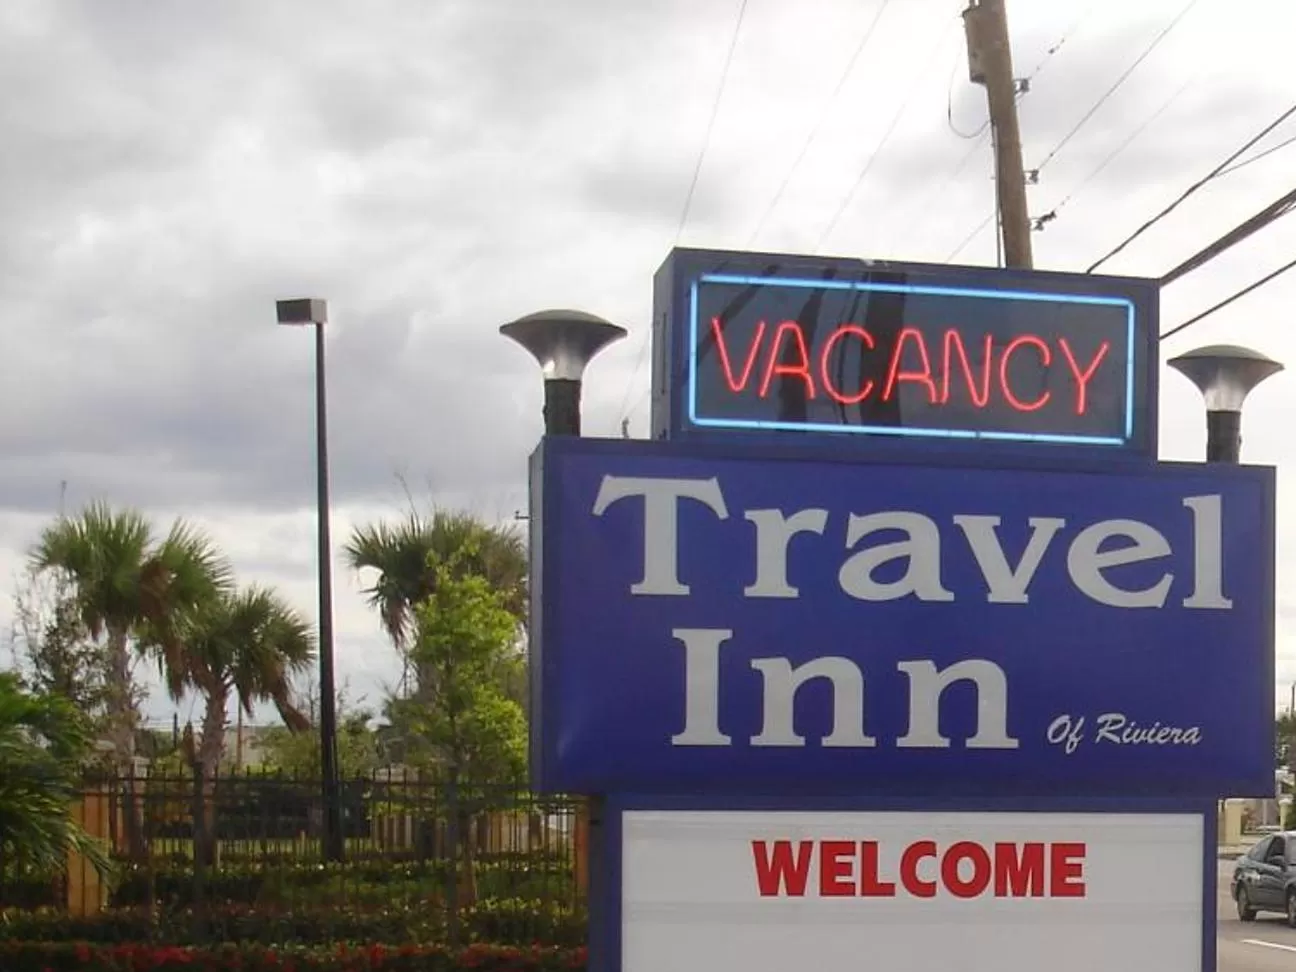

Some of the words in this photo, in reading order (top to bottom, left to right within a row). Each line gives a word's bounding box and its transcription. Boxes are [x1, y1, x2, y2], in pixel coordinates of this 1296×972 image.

[711, 317, 1108, 416] VACANCY
[592, 474, 1233, 609] Travel
[671, 628, 1019, 749] Inn
[1047, 714, 1085, 754] Of
[1096, 713, 1202, 745] Riviera
[752, 840, 1086, 898] WELCOME
